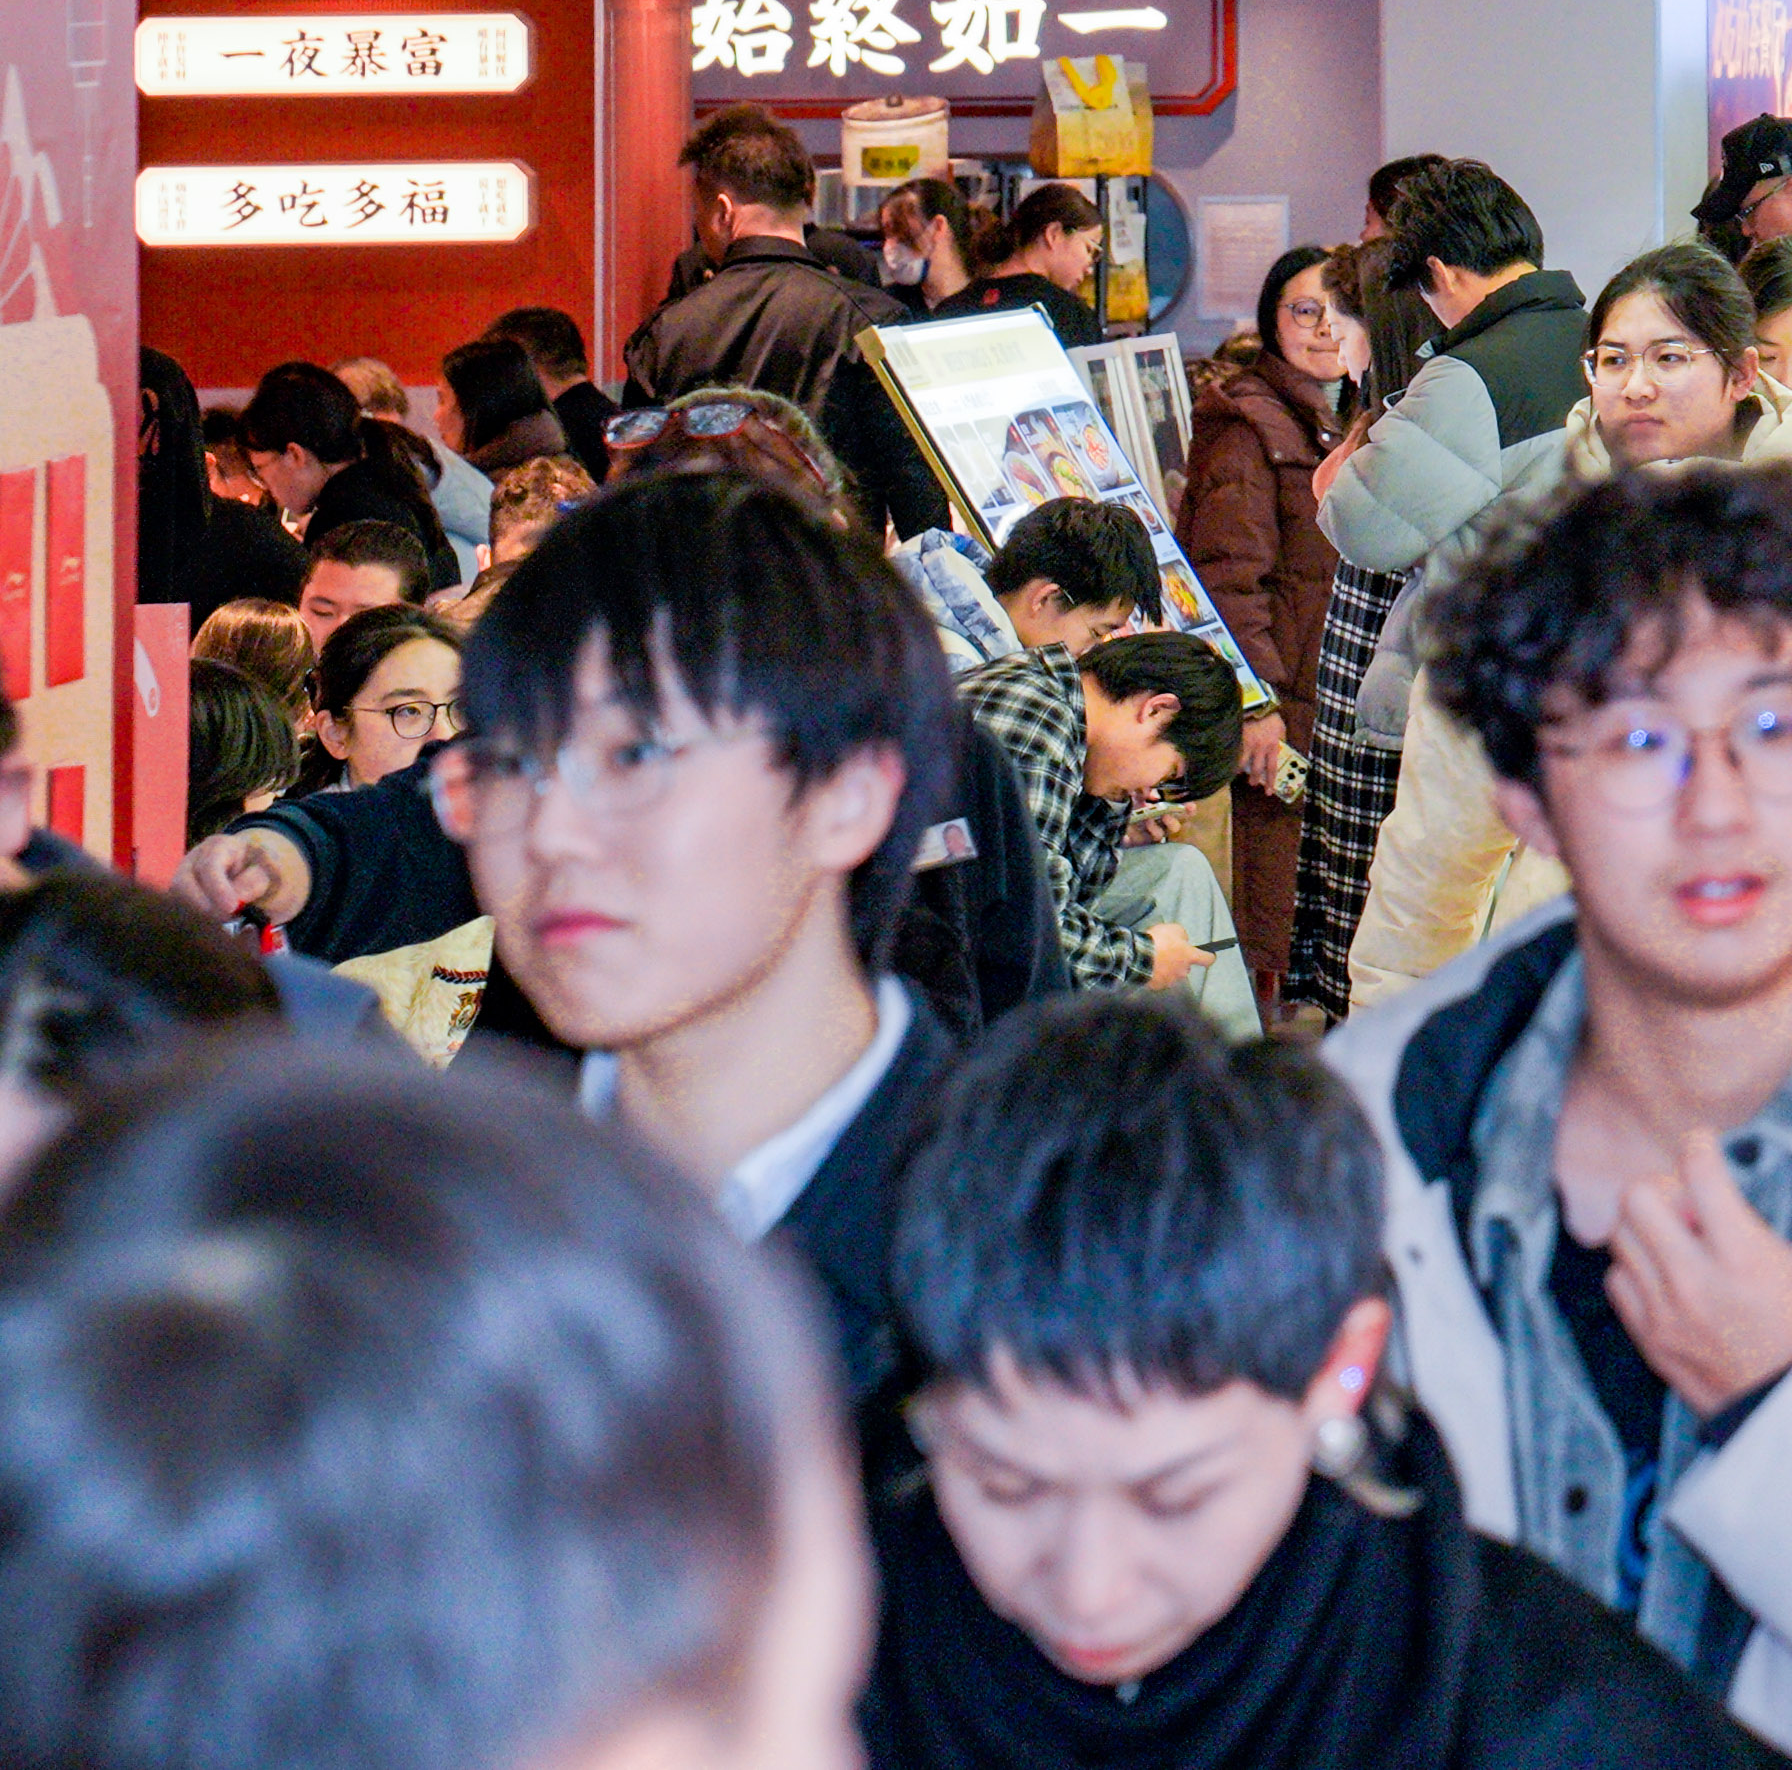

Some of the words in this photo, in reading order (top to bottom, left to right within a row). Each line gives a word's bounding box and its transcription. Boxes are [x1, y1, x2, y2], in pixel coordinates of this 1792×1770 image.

[219, 28, 449, 79] 一夜暴富
[221, 178, 451, 231] 多吃多福
